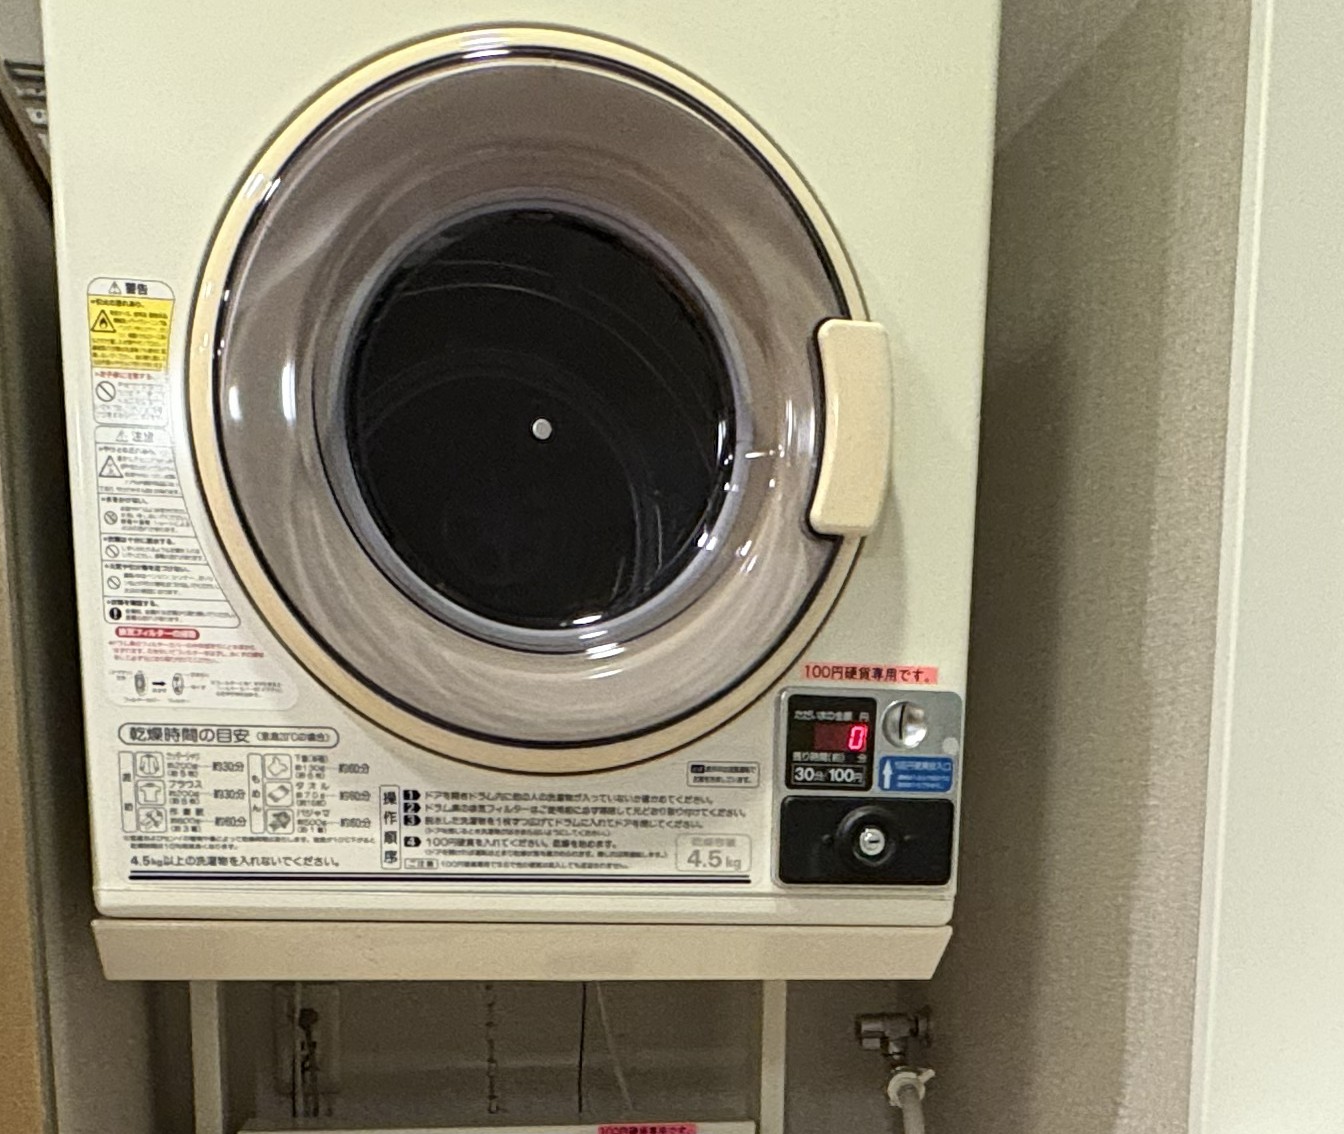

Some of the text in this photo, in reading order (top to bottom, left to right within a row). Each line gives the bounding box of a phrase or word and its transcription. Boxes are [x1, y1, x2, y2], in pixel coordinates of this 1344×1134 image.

[804, 665, 930, 682] 100円硬貨専用です。
[129, 727, 250, 743] 乾燥時間の目安
[848, 725, 865, 750] 0
[382, 790, 398, 866] 操作順序
